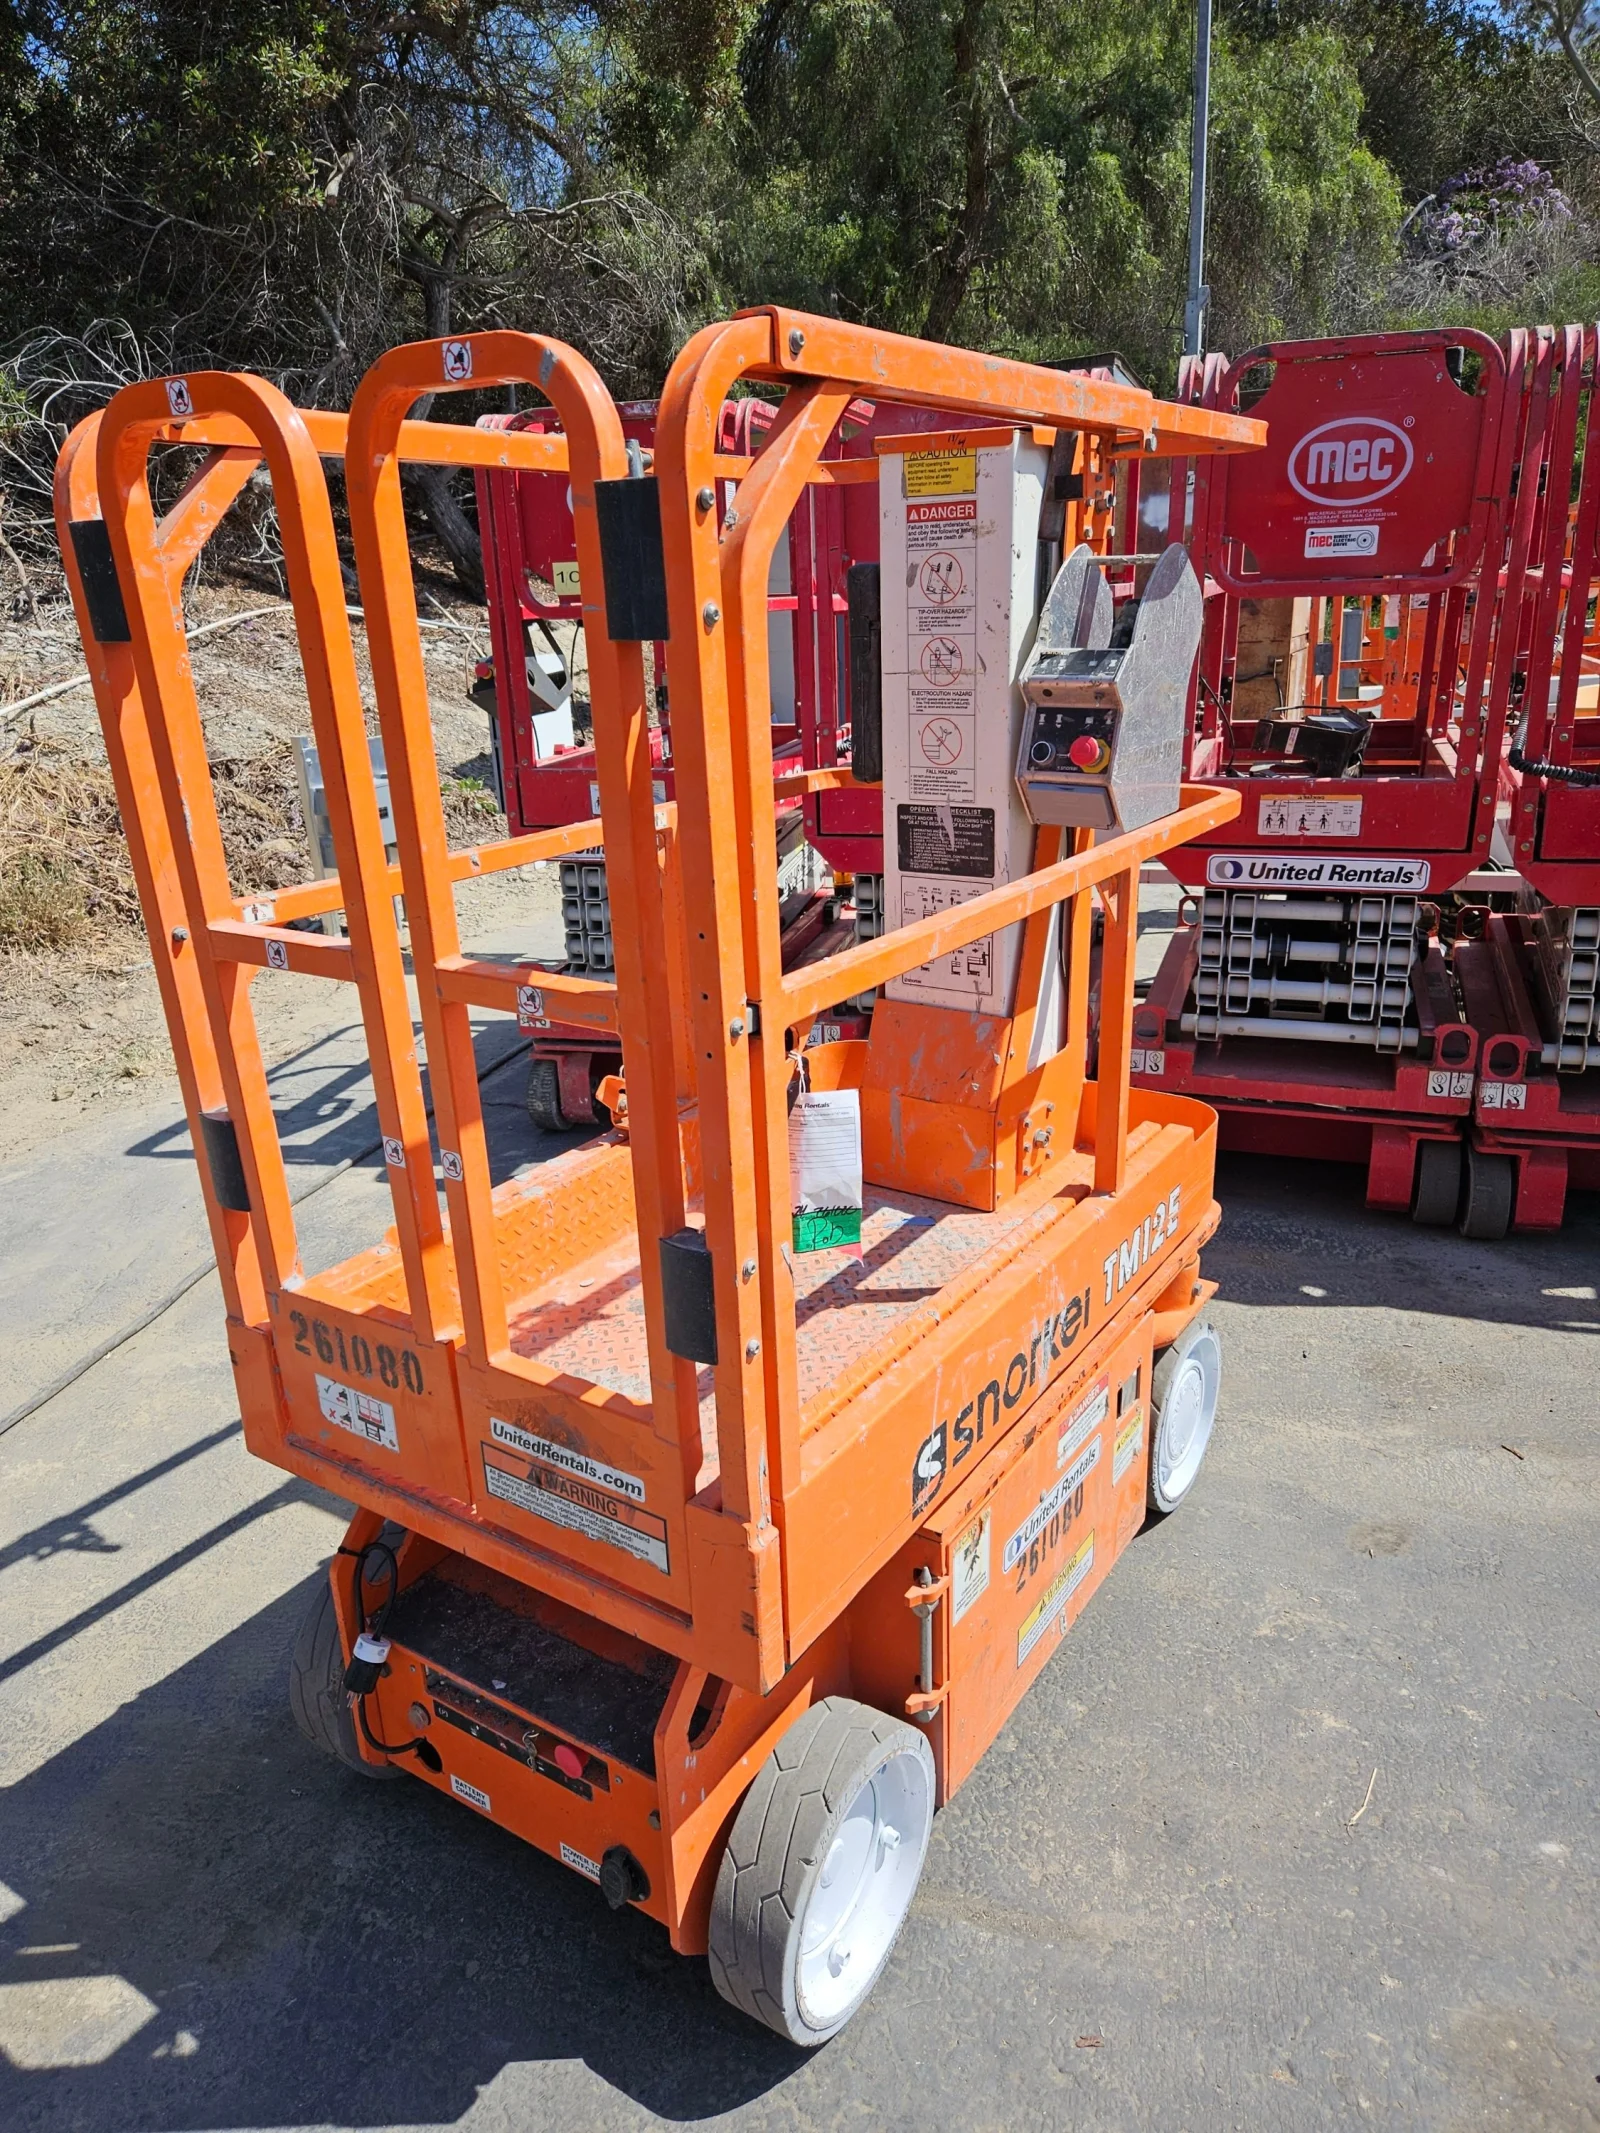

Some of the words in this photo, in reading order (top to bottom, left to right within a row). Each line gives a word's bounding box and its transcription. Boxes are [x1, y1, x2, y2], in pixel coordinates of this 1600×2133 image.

[920, 505, 974, 520] DANGER
[1248, 863, 1325, 882] United
[1328, 864, 1415, 884] Rentals
[290, 1310, 424, 1396] 261080
[493, 1422, 643, 1497] UnitedRentals.com
[523, 1490, 540, 1502] safety
[556, 1506, 584, 1522] operating
[584, 1516, 619, 1536] instructions
[542, 1470, 619, 1518] WARNING
[1024, 1491, 1060, 1542] United
[1060, 1447, 1097, 1499] Rentals
[560, 1511, 578, 1525] before
[610, 1536, 650, 1557] maintenance
[573, 1505, 599, 1521] Carefully
[616, 1524, 650, 1544] understand
[1016, 1481, 1084, 1595] 261080
[1043, 1555, 1077, 1605] WARNING
[454, 1778, 486, 1800] BATTERY
[455, 1785, 487, 1808] CHARGER
[563, 1845, 590, 1865] POWER
